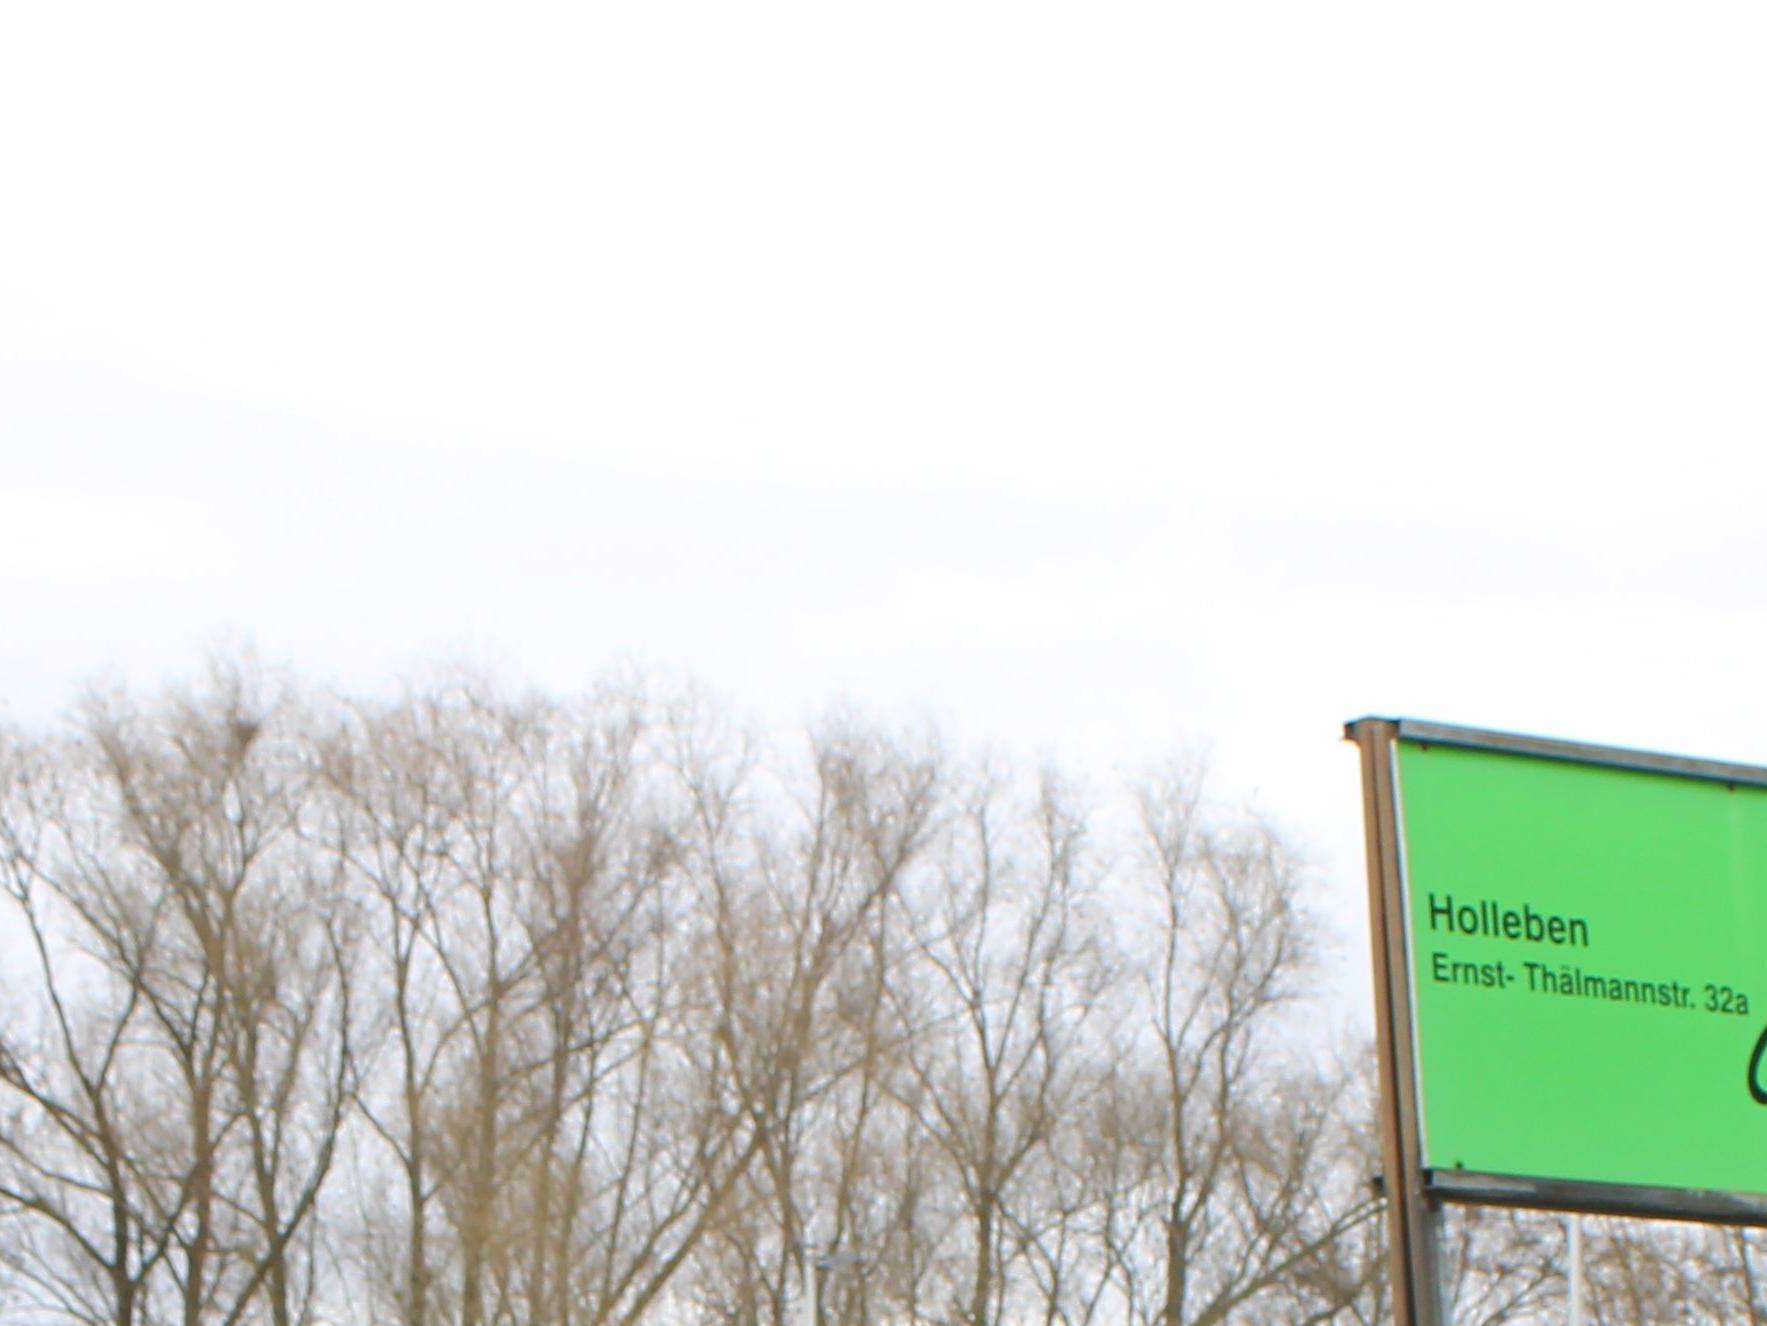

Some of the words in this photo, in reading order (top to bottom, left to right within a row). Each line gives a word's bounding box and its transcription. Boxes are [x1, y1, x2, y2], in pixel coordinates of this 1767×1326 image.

[1428, 892, 1590, 948] Holleben
[1432, 952, 1515, 989] Ernst-
[1523, 961, 1697, 1010] Thälmannstr.
[1704, 983, 1750, 1016] 32a
